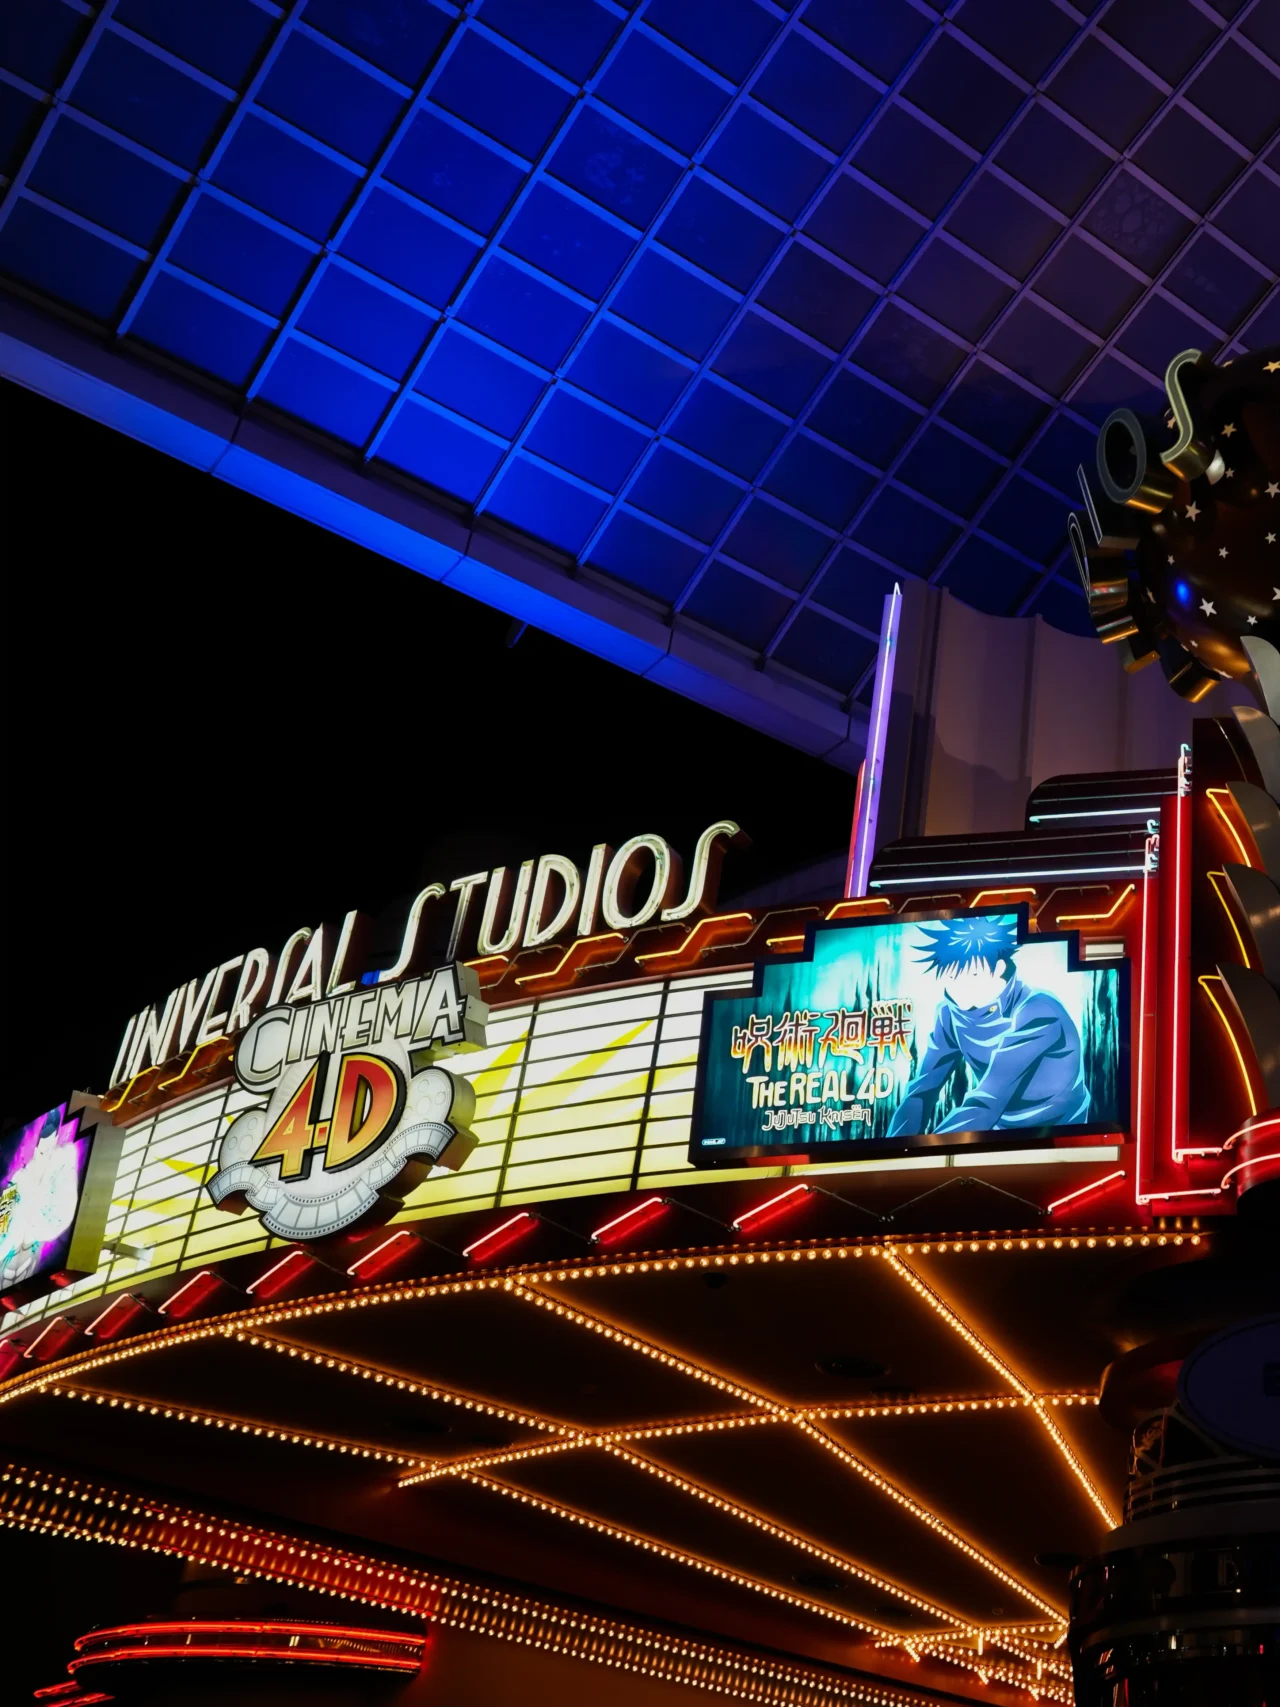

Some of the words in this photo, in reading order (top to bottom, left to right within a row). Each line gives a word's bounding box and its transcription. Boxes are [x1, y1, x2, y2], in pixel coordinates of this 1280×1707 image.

[109, 909, 358, 1089] UNIVERSAL
[378, 819, 741, 984] STUDIOS
[235, 966, 466, 1090] CINEMA
[731, 1000, 914, 1074] 呪術廻戦
[745, 1075, 788, 1109] THE
[789, 1070, 855, 1106] REAL
[853, 1067, 895, 1105] 4D
